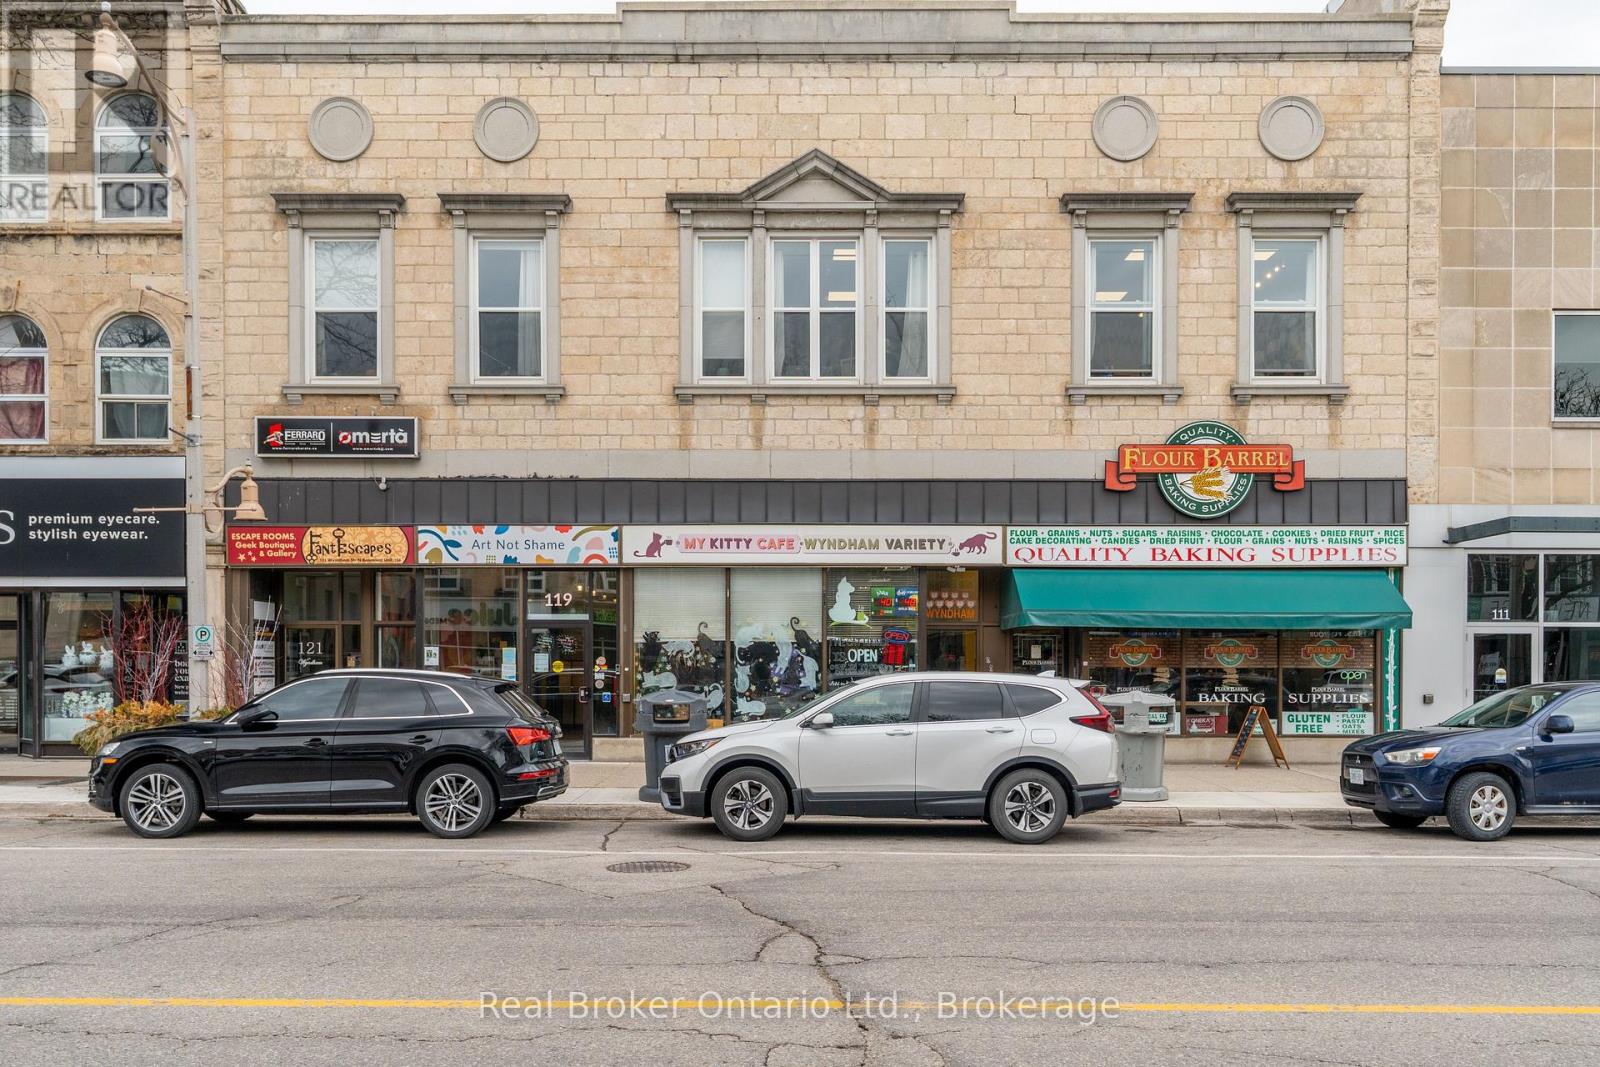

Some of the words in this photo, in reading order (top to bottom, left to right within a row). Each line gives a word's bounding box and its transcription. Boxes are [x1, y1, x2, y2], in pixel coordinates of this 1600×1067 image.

[285, 430, 326, 440] FERRARO
[1180, 426, 1233, 441] QUALITY
[1124, 447, 1196, 470] FLOUR
[1202, 447, 1289, 470] BARREL
[1164, 479, 1196, 511] BAKING
[1201, 478, 1248, 513] SUPPLIES
[28, 513, 93, 526] premium
[98, 514, 160, 526] eyecare.
[28, 528, 77, 542] stylish
[82, 530, 148, 542] eyewear.
[231, 532, 261, 540] ESCAPE
[235, 540, 257, 549] Geek
[471, 539, 491, 550] Art
[496, 539, 519, 550] Not
[524, 539, 565, 550] Shame
[684, 537, 706, 550] MY
[709, 537, 753, 550] KITTY
[756, 538, 795, 550] CAFE
[804, 538, 880, 550] WYNDHAM
[885, 538, 946, 550] VARIETY
[266, 549, 297, 559] Gallery
[1014, 547, 1133, 563] QUALITY
[1151, 547, 1256, 562] BAKING
[1272, 547, 1397, 562] SUPPLIES
[544, 592, 573, 607] 119
[1492, 609, 1510, 620] 111
[200, 630, 207, 639] P
[884, 631, 910, 641] OPEN
[298, 642, 323, 655] 121
[848, 648, 878, 663] OPEN
[1340, 671, 1367, 681] open
[1197, 692, 1266, 703] BAKING
[1288, 693, 1369, 704] SUPPLIES
[1287, 714, 1331, 723] GLUTEN
[1295, 724, 1323, 733] FREE
